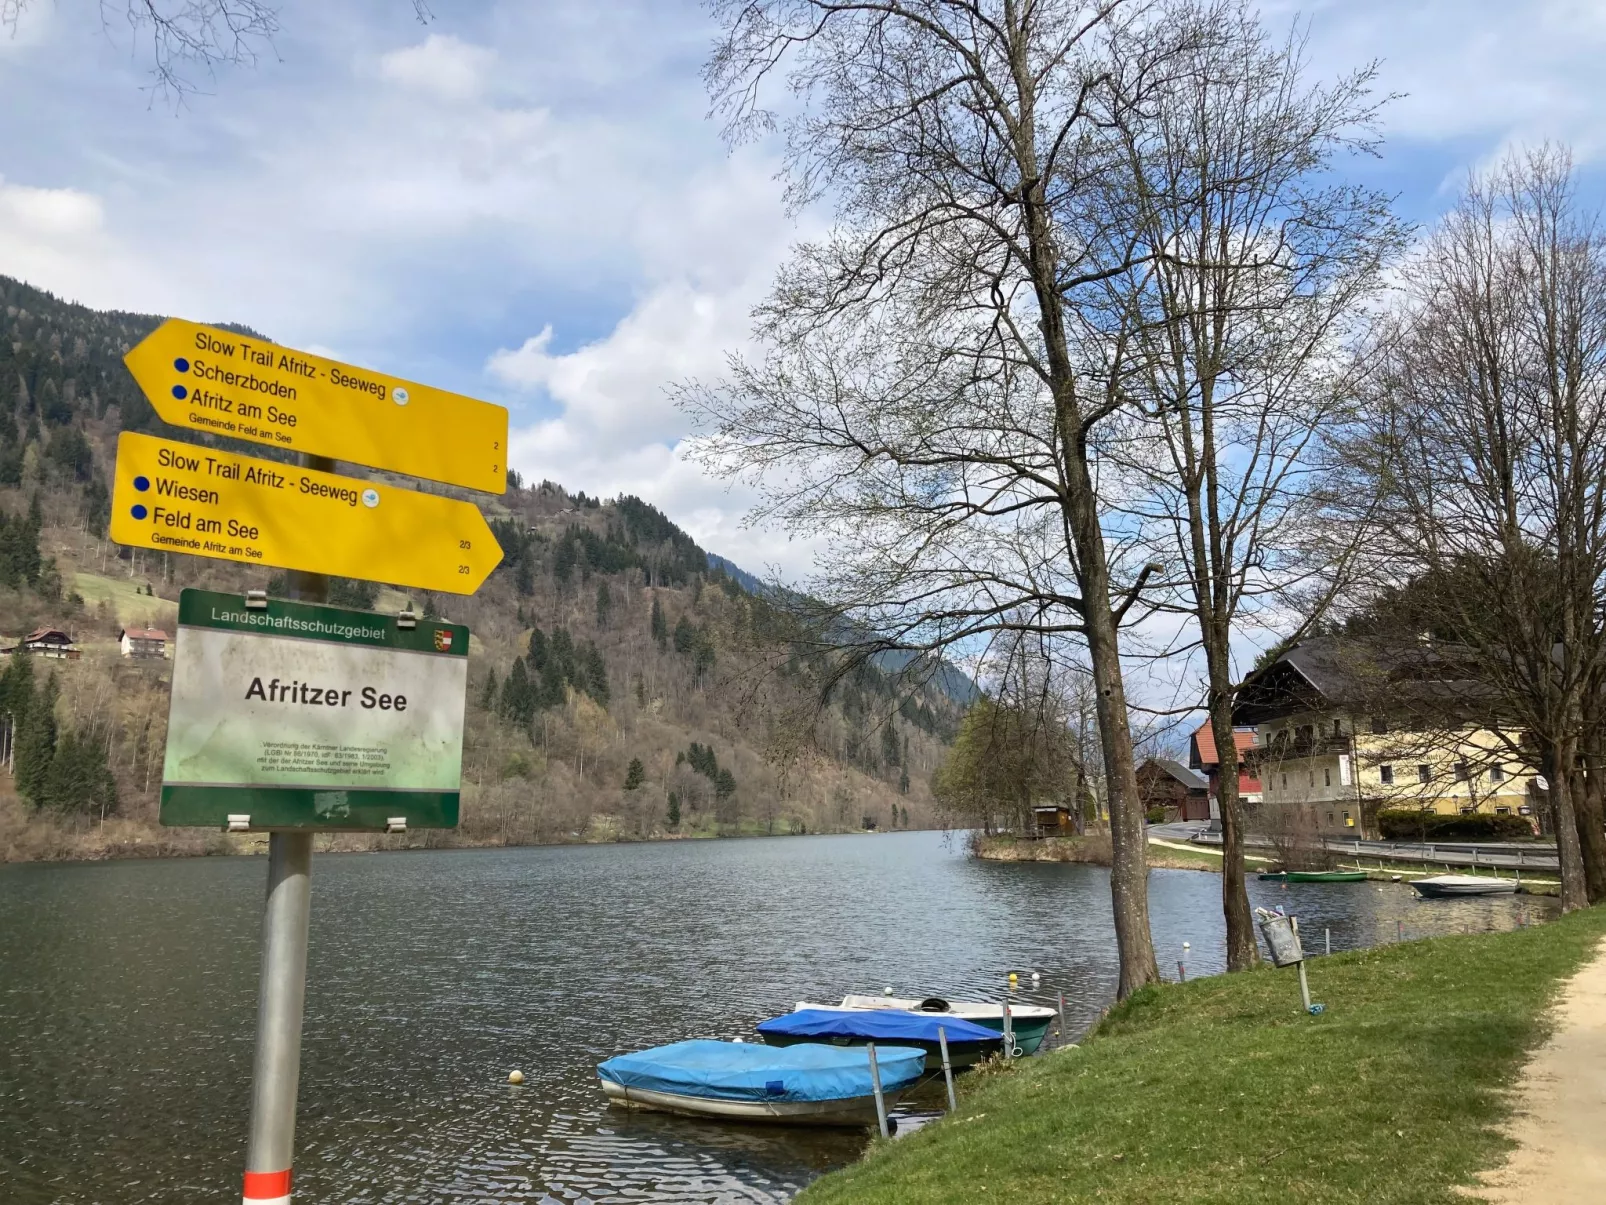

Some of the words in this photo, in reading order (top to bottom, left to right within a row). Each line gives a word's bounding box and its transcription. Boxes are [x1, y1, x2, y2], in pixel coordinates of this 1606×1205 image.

[193, 360, 297, 401] Scherzboden
[195, 332, 235, 357] Slow
[240, 343, 274, 368] Trail
[278, 355, 316, 379] Afritz
[330, 368, 386, 401] Seeweg
[190, 388, 233, 413] Afritz
[237, 402, 262, 420] am
[267, 406, 297, 428] See
[189, 412, 236, 432] Gemeinde
[238, 424, 258, 436] Feld
[260, 430, 273, 440] am
[275, 432, 292, 444] See
[494, 442, 499, 450] 2
[158, 448, 200, 472] Slow
[205, 457, 240, 480] Trail
[244, 466, 285, 489] Afritz
[300, 477, 358, 508] Seeweg
[493, 465, 498, 473] 2
[156, 477, 219, 505] Wiesen
[153, 507, 192, 530] Feld
[196, 518, 222, 535] am
[228, 519, 259, 540] See
[152, 532, 201, 550] Gemeinde
[203, 541, 226, 554] Afritz
[228, 546, 243, 556] am
[245, 546, 262, 559] See
[460, 540, 471, 550] 2/3
[458, 565, 470, 574] 2/3
[211, 607, 386, 640] Landschaftsschutzgebiet
[245, 677, 352, 707] Afritzer
[360, 686, 408, 712] See
